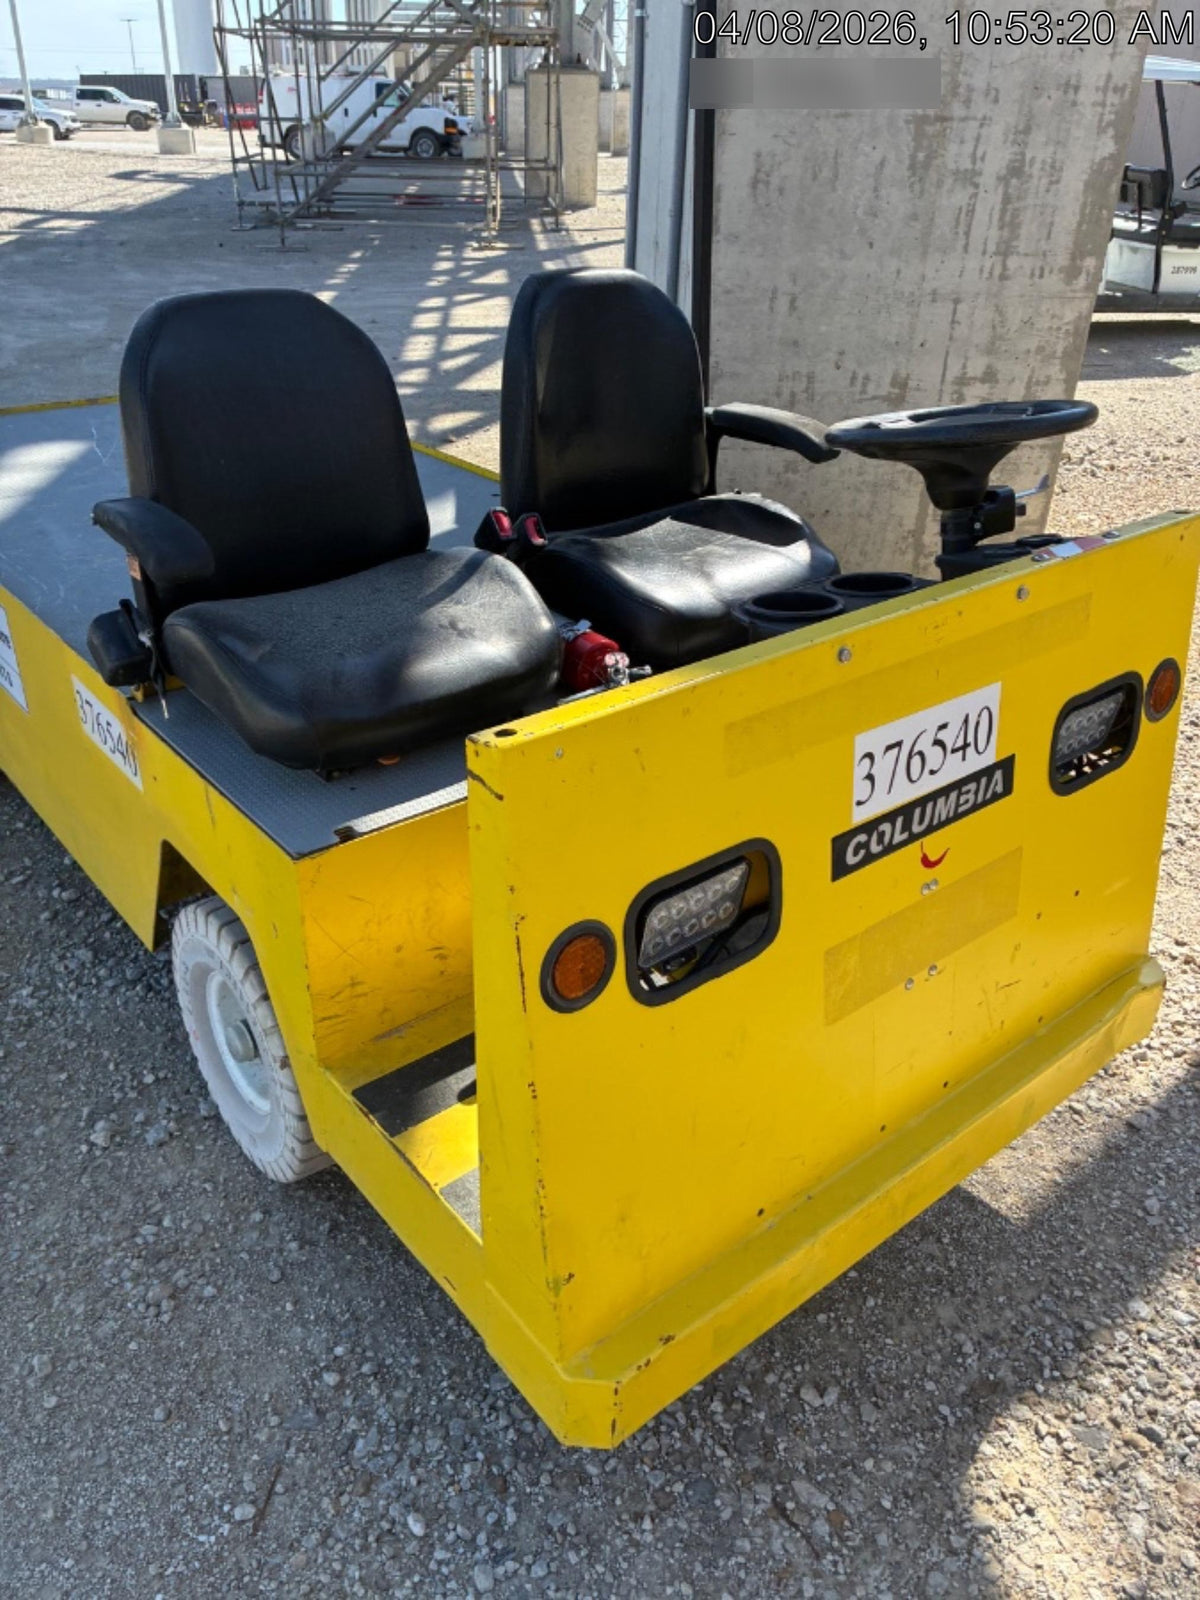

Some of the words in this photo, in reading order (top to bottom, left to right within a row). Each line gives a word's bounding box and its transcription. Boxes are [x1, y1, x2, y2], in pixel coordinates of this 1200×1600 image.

[75, 689, 138, 777] 376540
[855, 705, 993, 807] 376540
[845, 769, 1004, 865] COLUMBIA
